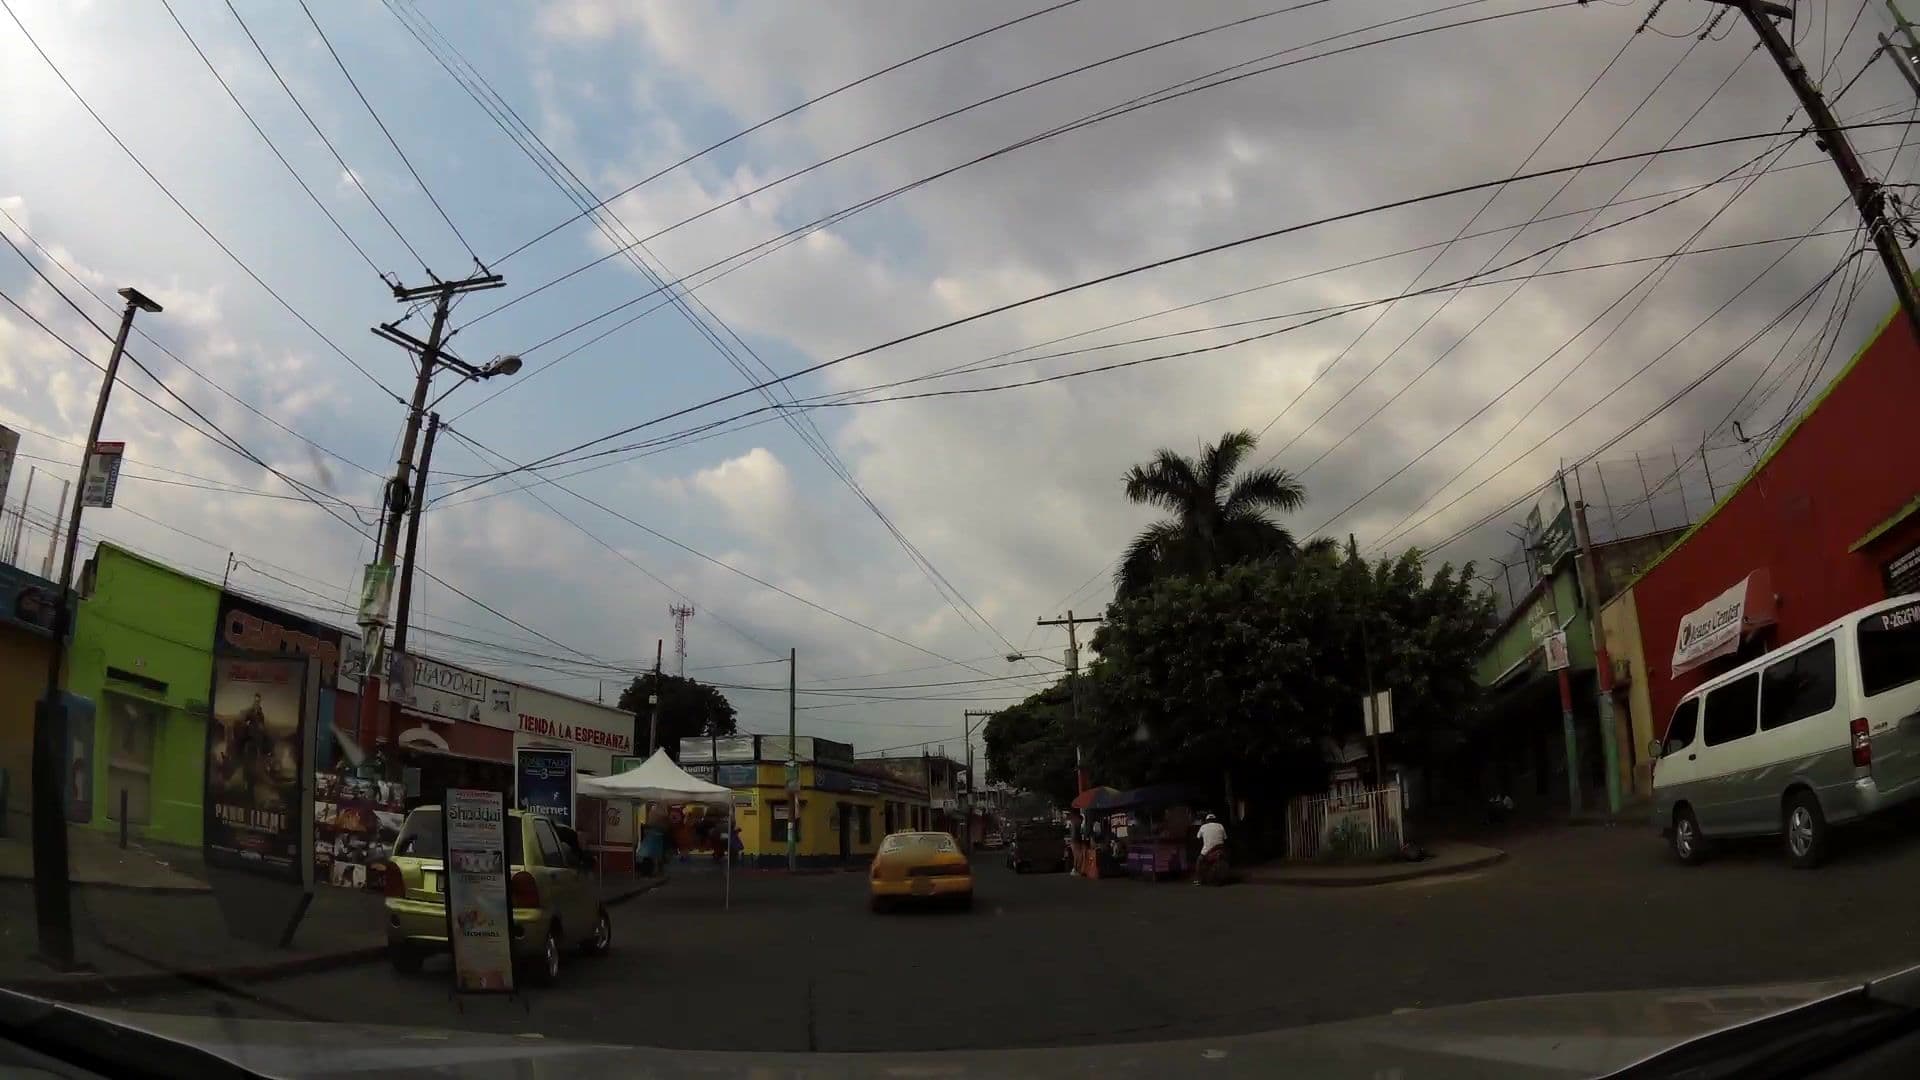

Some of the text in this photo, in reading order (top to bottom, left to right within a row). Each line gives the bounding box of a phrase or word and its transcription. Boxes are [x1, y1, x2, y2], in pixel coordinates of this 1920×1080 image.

[518, 712, 630, 750] TIENDA LA ESPERANZA
